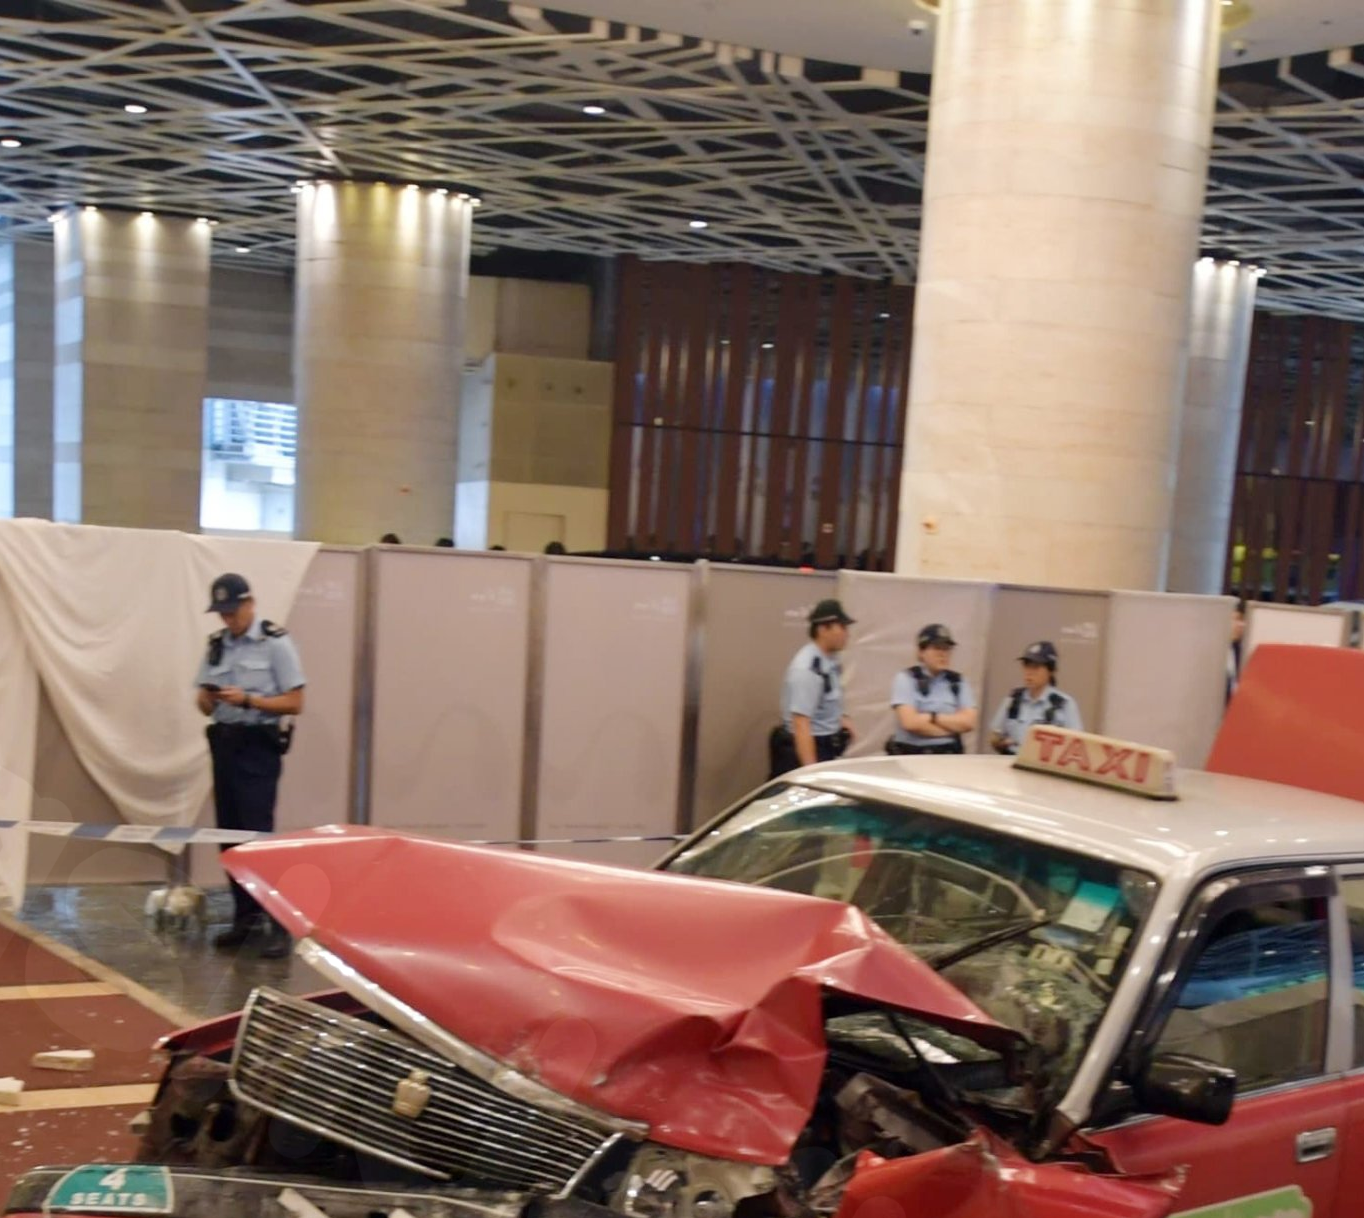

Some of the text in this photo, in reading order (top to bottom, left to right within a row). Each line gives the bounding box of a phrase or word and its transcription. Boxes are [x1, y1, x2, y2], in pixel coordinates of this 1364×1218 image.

[1033, 730, 1150, 783] TAXI
[99, 1168, 129, 1191] 4
[69, 1192, 148, 1206] SEATS
